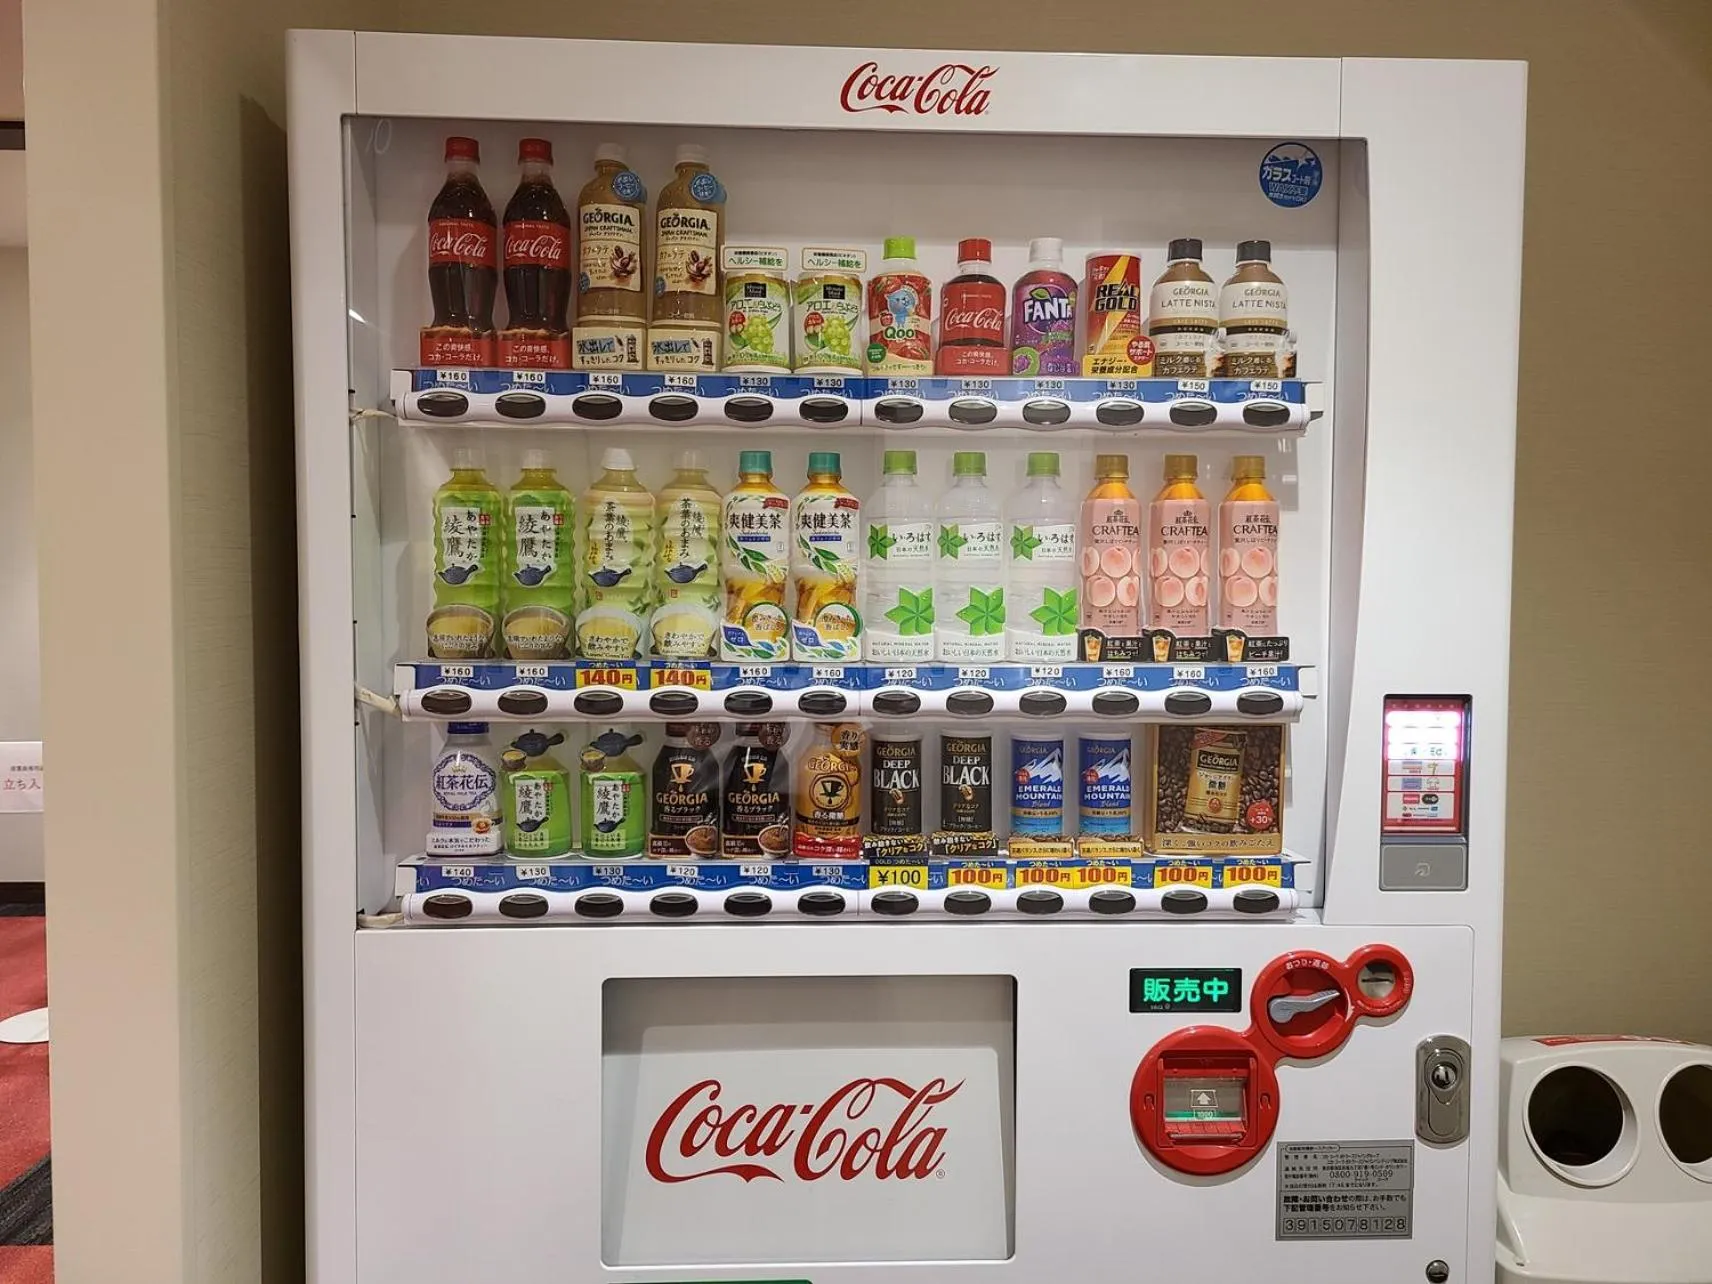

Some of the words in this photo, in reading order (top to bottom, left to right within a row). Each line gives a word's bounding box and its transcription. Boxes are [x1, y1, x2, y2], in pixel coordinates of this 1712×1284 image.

[840, 62, 1000, 116] Coca-Cola
[430, 232, 488, 258] Coca-Cola
[504, 234, 562, 260] Coca-Cola
[1096, 280, 1138, 298] REAL
[1095, 297, 1137, 312] GOLD
[944, 308, 1002, 331] Coca-Cola
[884, 327, 915, 340] Qoo
[440, 371, 467, 381] ¥160
[516, 372, 543, 382] ¥160
[592, 375, 619, 384] ¥160
[668, 376, 695, 386] ¥160
[742, 376, 768, 386] ¥130
[816, 378, 842, 387] ¥130
[890, 380, 916, 389] ¥130
[964, 380, 990, 389] ¥130
[1037, 380, 1062, 390] ¥130
[1110, 381, 1136, 390] ¥130
[1181, 382, 1206, 390] ¥150
[1254, 382, 1278, 390] ¥150
[729, 512, 782, 530] 爽健美茶
[801, 512, 852, 530] 爽健美茶
[1092, 525, 1140, 536] CRAFTEA
[1160, 526, 1208, 536] CRAFTEA
[1233, 524, 1278, 535] CRAFTEA
[443, 514, 465, 558] 綾鷹
[466, 510, 478, 562] あやたか
[518, 514, 540, 558] 綾鷹
[540, 510, 553, 562] あやたか
[444, 667, 471, 676] ¥160
[520, 667, 545, 676] ¥160
[742, 667, 768, 676] ¥160
[816, 669, 841, 678] ¥160
[888, 669, 913, 678] ¥120
[962, 669, 987, 678] ¥120
[1034, 668, 1060, 676] ¥120
[1105, 668, 1131, 676] ¥160
[1176, 669, 1202, 678] ¥160
[1250, 667, 1275, 676] ¥160
[580, 670, 633, 686] 140円
[655, 670, 707, 686] 140円
[876, 744, 916, 758] GEORGIA
[946, 742, 986, 753] GEORGIA
[882, 759, 911, 769] DEEP
[952, 755, 981, 765] DEEP
[1200, 753, 1238, 767] GEORGIA
[873, 768, 920, 790] BLACK
[942, 766, 990, 786] BLACK
[2, 778, 41, 790] 立ち入
[436, 774, 488, 790] 紅茶花伝
[1018, 784, 1062, 793] EMERALD
[518, 784, 533, 815] 綾鷹
[596, 785, 612, 816] 綾鷹
[656, 790, 709, 805] GEORGIA
[728, 790, 780, 805] GEORGIA
[445, 867, 472, 877] ¥140
[520, 867, 547, 876] ¥130
[669, 865, 696, 876] ¥120
[743, 865, 770, 875] ¥120
[814, 867, 840, 876] ¥130
[1020, 868, 1071, 883] 100円
[1077, 867, 1128, 883] 100円
[1158, 867, 1209, 882] 100円
[1226, 866, 1278, 882] 100円
[878, 870, 921, 885] ¥100
[952, 869, 1003, 884] 100円
[1143, 976, 1229, 1003] 販売中
[644, 1078, 966, 1184] Coca-Cola
[1285, 1218, 1406, 1232] 3915078128
